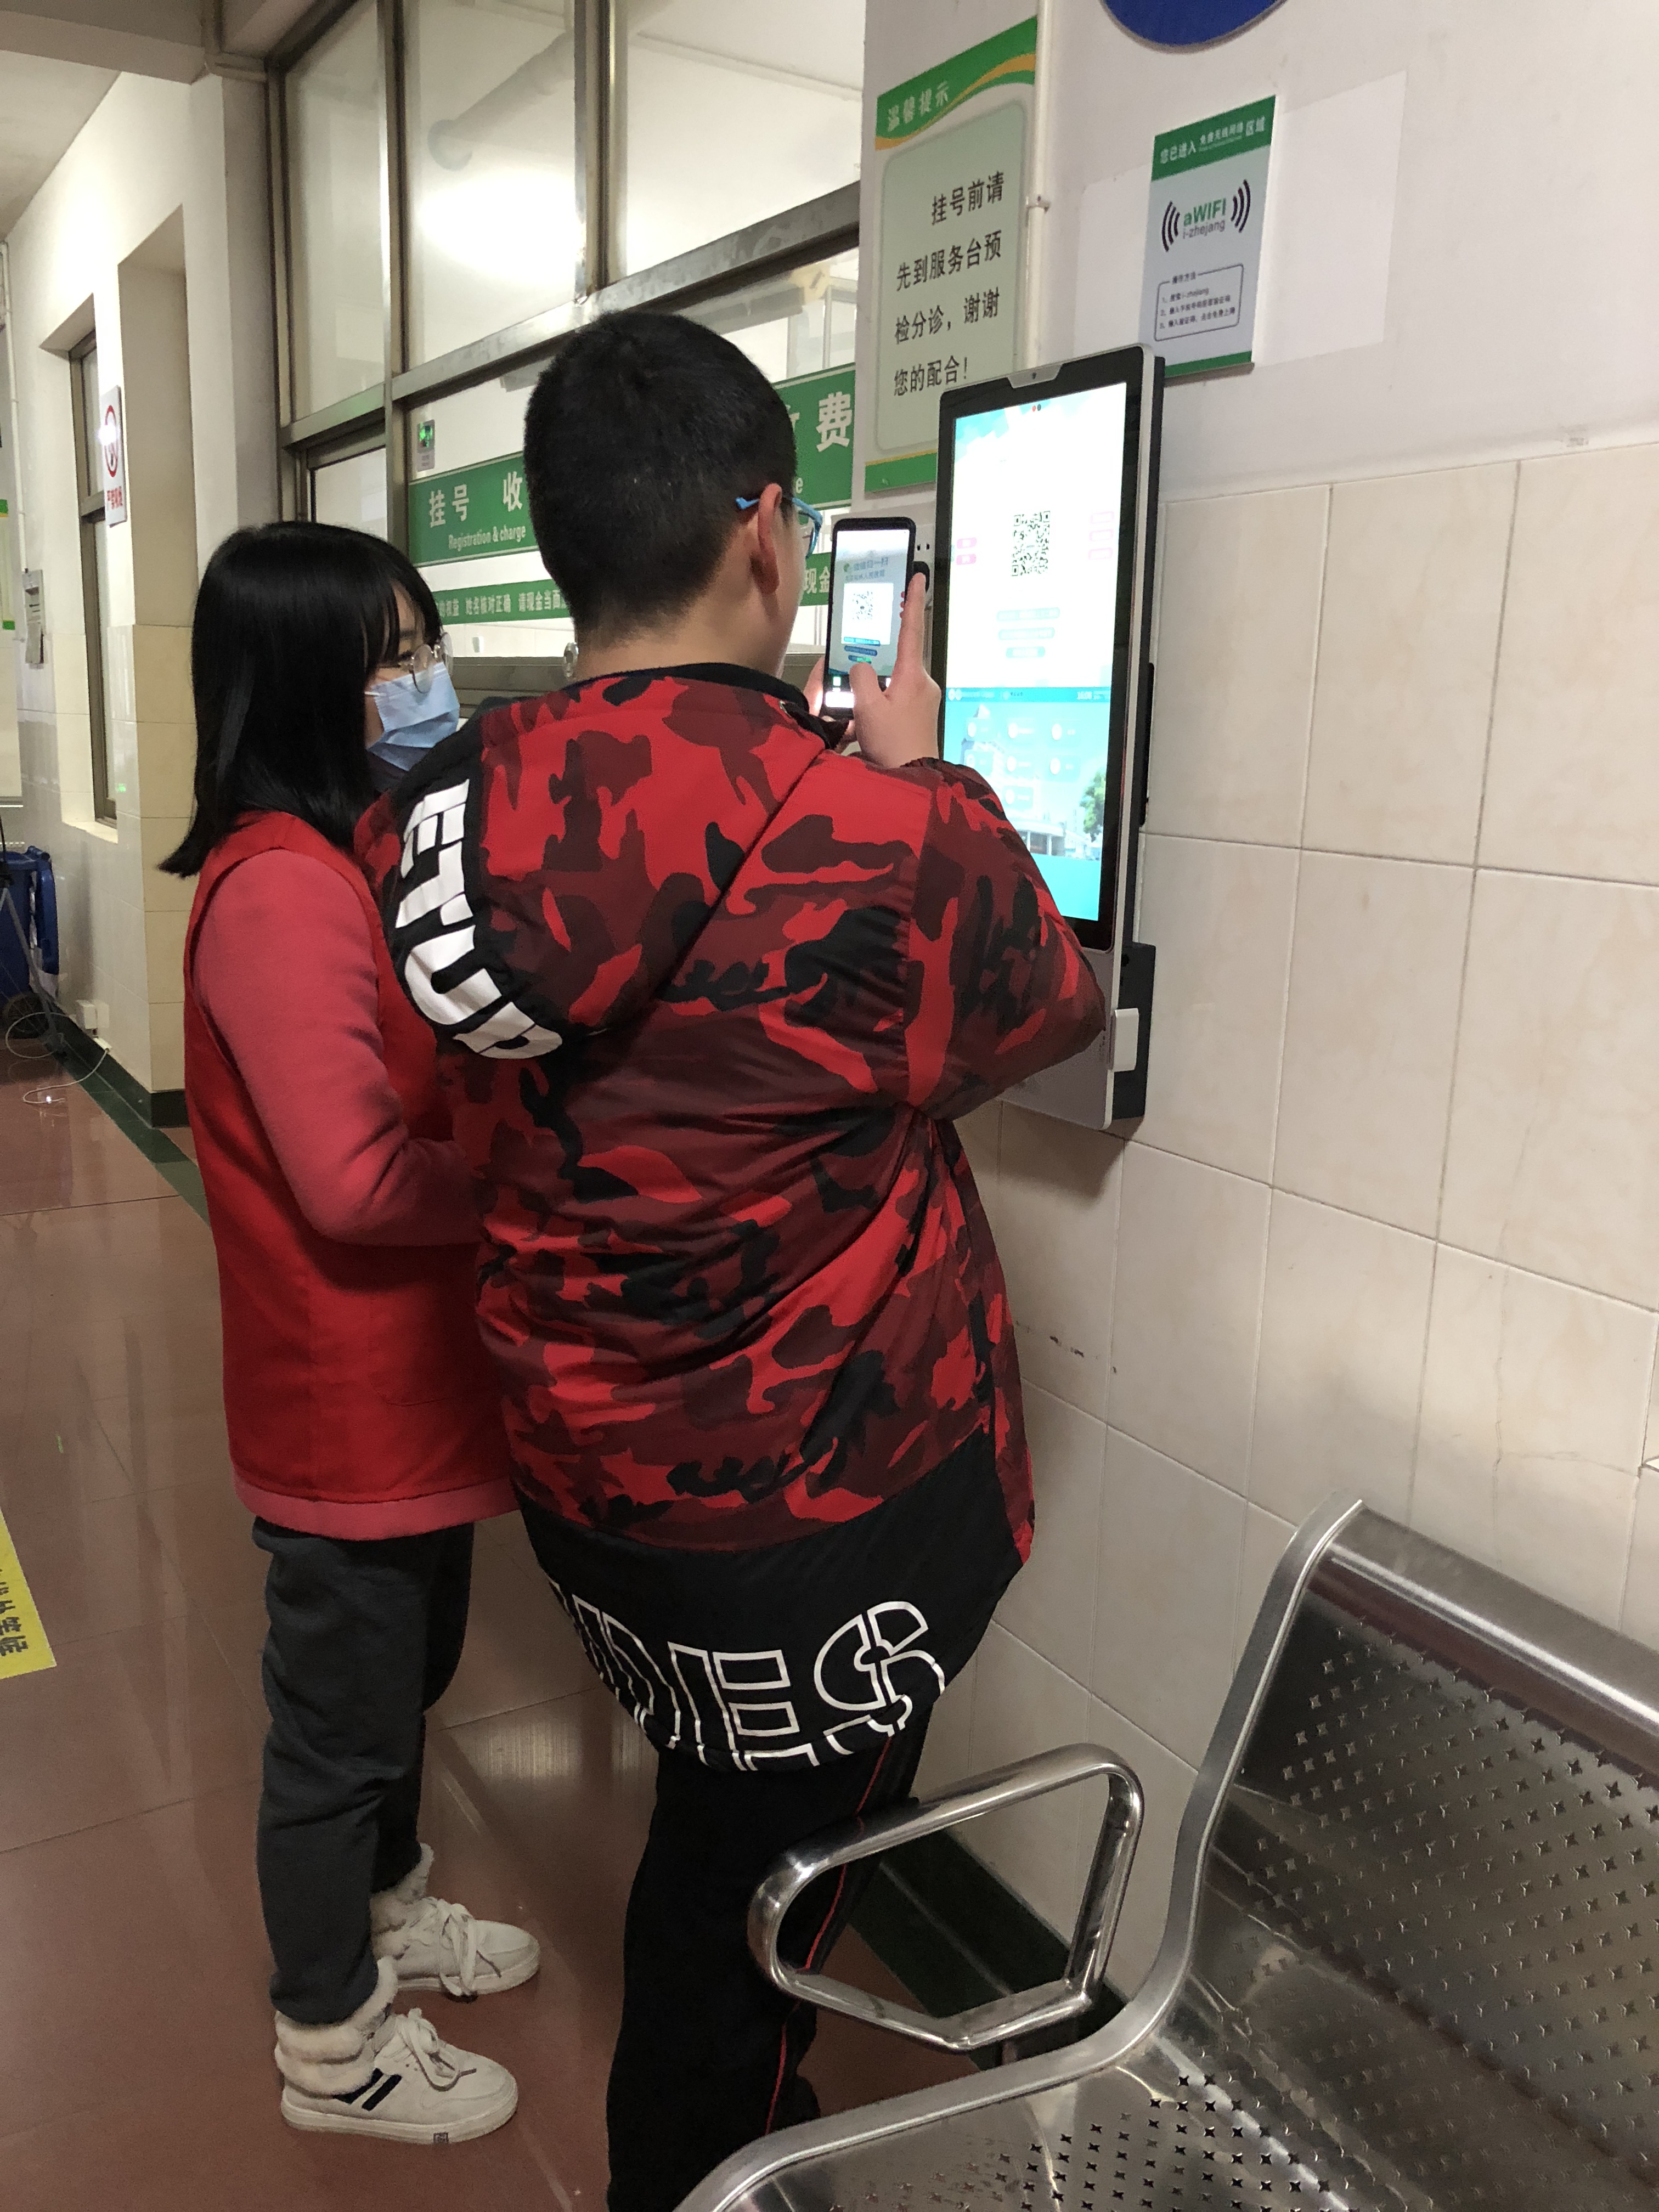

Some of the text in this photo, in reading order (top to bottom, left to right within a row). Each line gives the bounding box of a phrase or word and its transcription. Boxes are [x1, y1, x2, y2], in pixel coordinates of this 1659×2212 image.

[932, 171, 1004, 225] 挂号前请
[1183, 197, 1227, 227] aWIFI
[896, 230, 1002, 292] 先到服务台预
[429, 471, 523, 528] 挂号 收
[449, 524, 526, 552] Registration & charge
